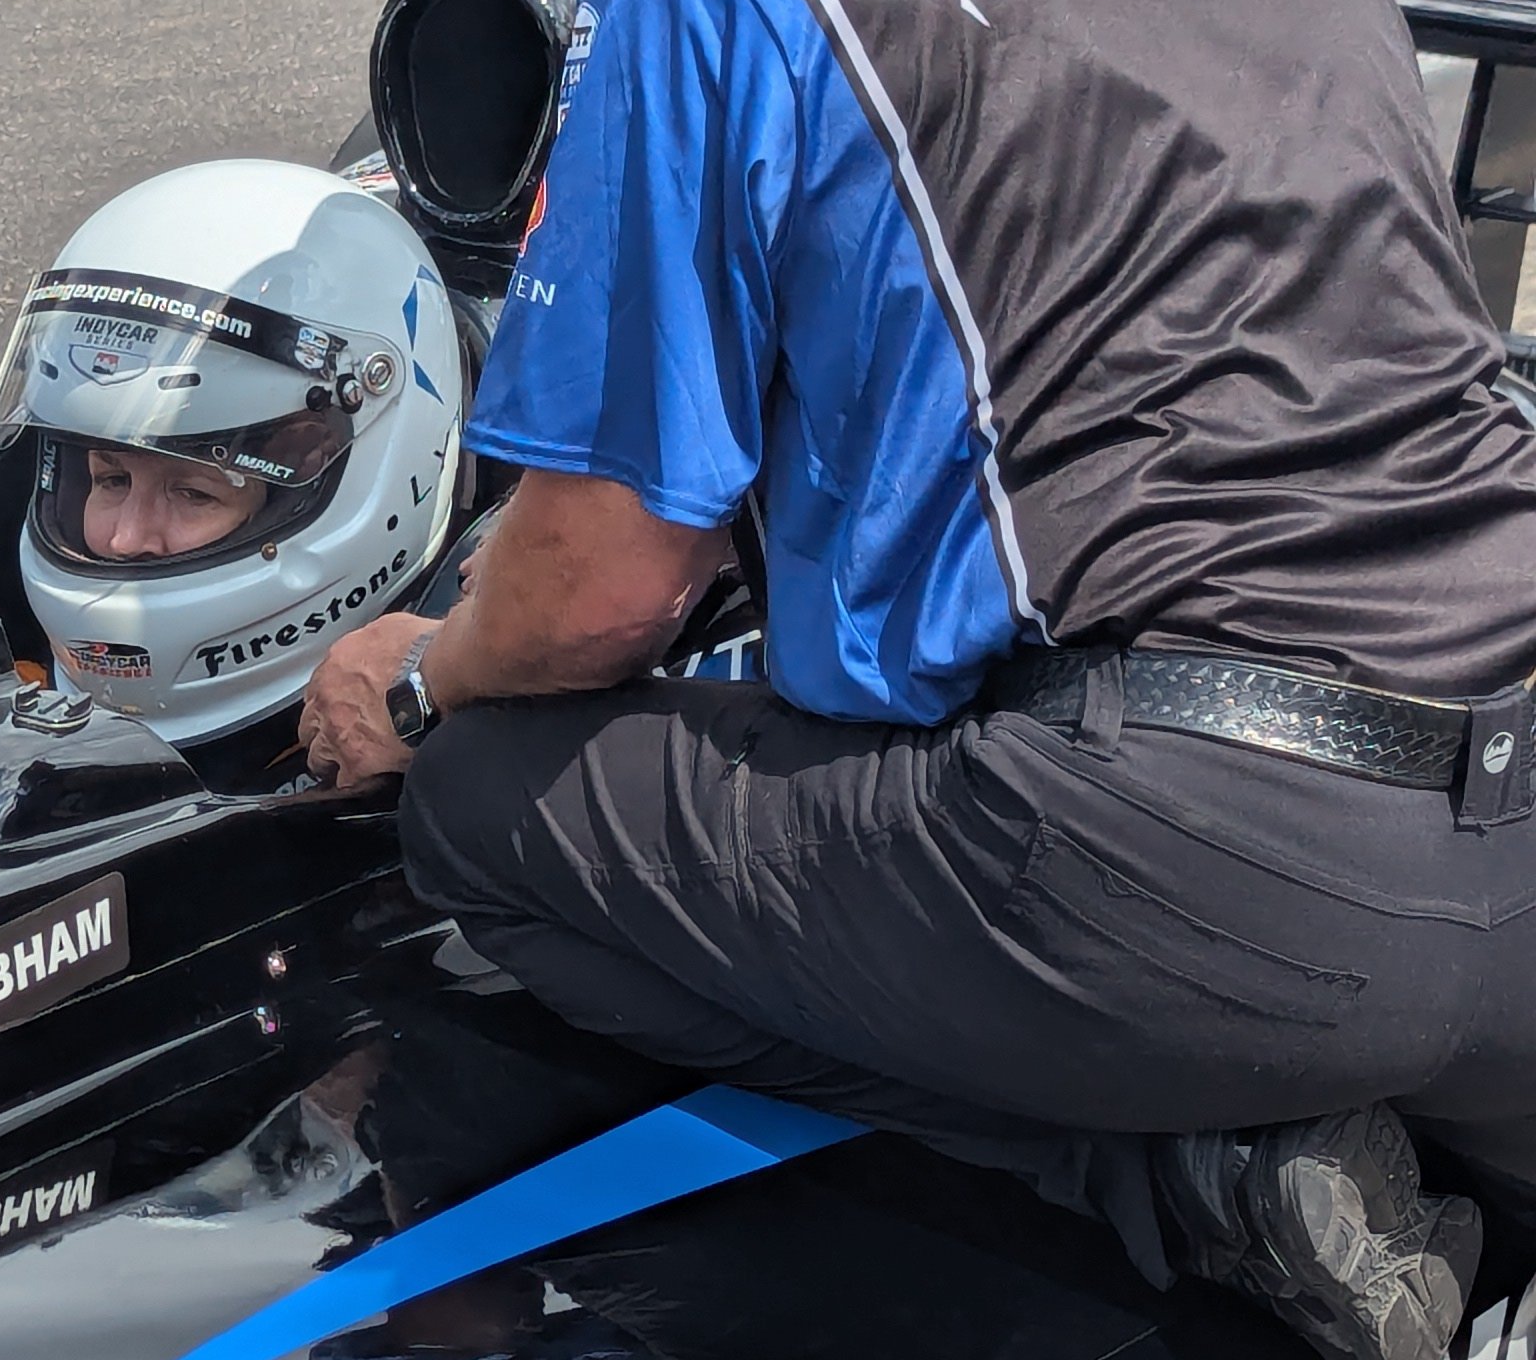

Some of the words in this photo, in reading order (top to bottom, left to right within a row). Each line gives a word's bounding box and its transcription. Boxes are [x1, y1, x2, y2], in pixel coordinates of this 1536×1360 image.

[74, 315, 158, 344] INDYCAR
[234, 453, 295, 479] IMPACT
[196, 549, 407, 678] Firestone
